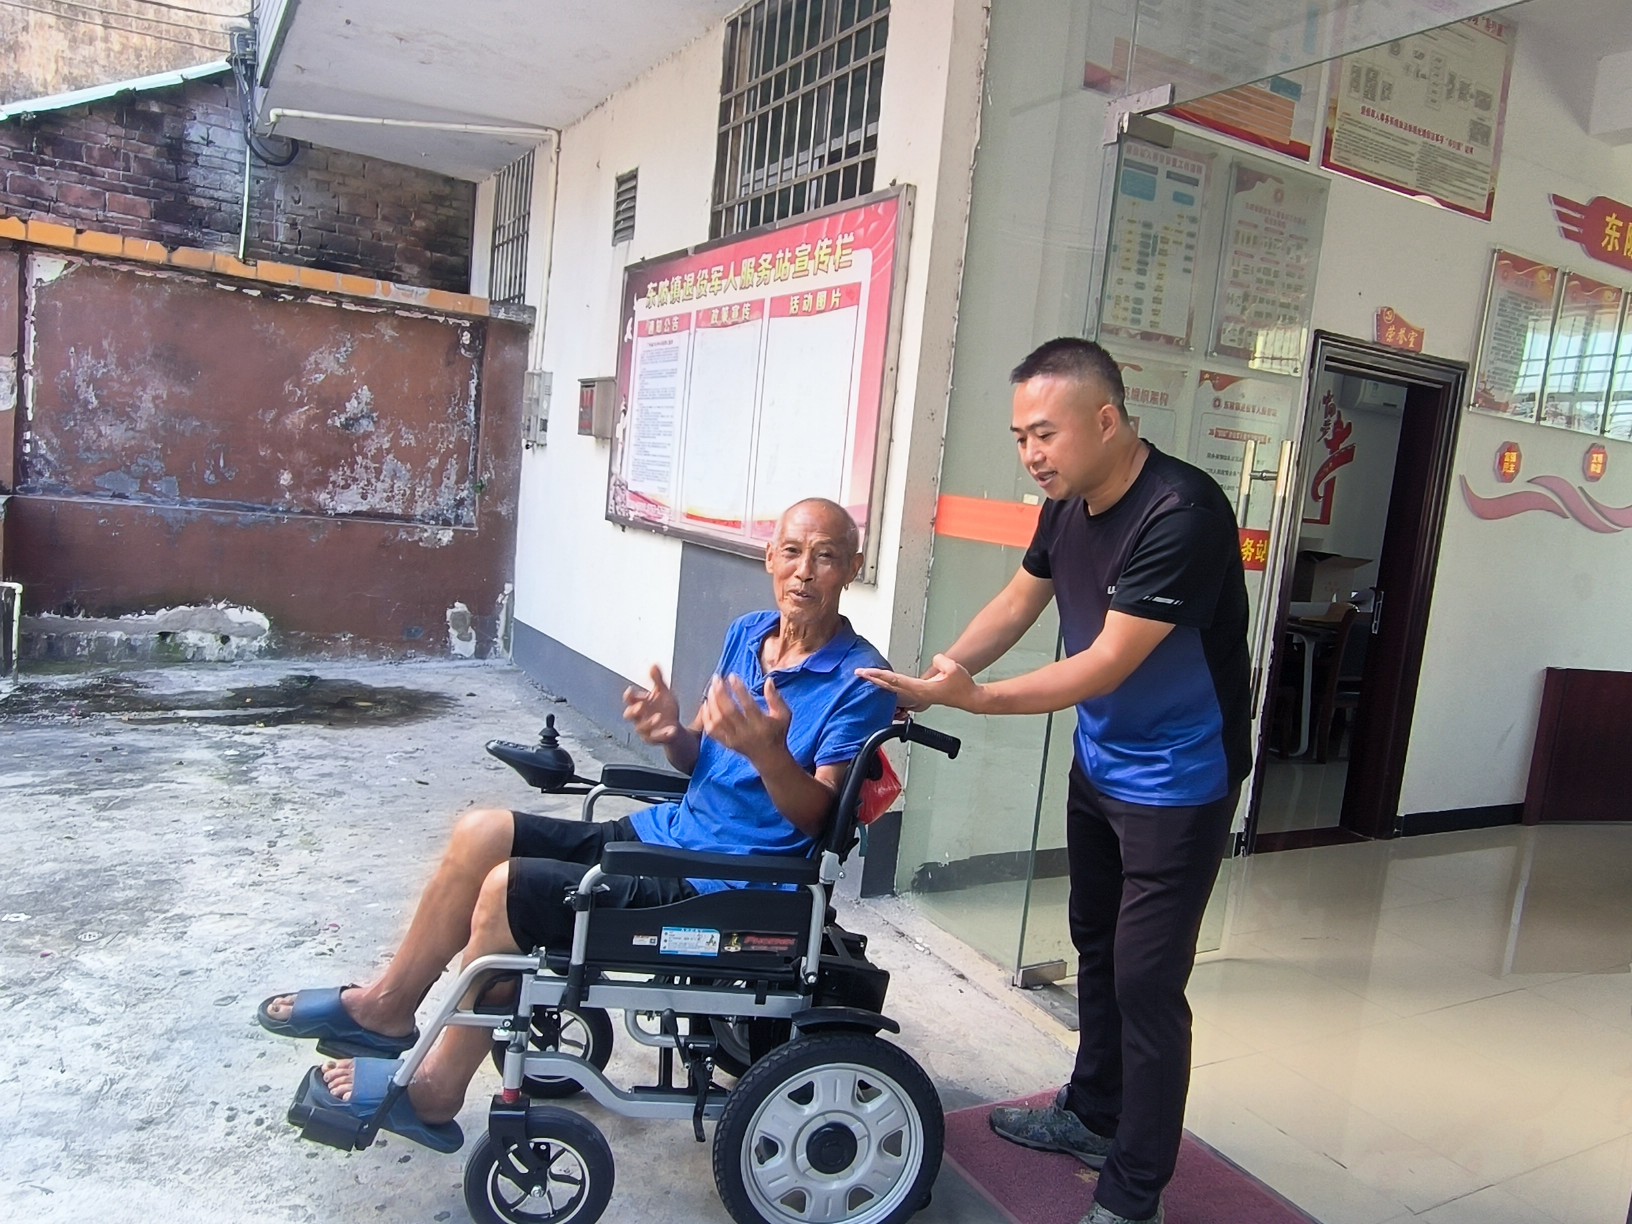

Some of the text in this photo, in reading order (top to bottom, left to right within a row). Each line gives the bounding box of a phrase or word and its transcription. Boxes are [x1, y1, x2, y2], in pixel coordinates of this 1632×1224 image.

[645, 231, 856, 310] 东陂镇退役军人服务站宣传栏
[789, 289, 842, 314] 活动图片
[647, 316, 680, 336] 通知公告
[710, 303, 752, 326] 政策宣传
